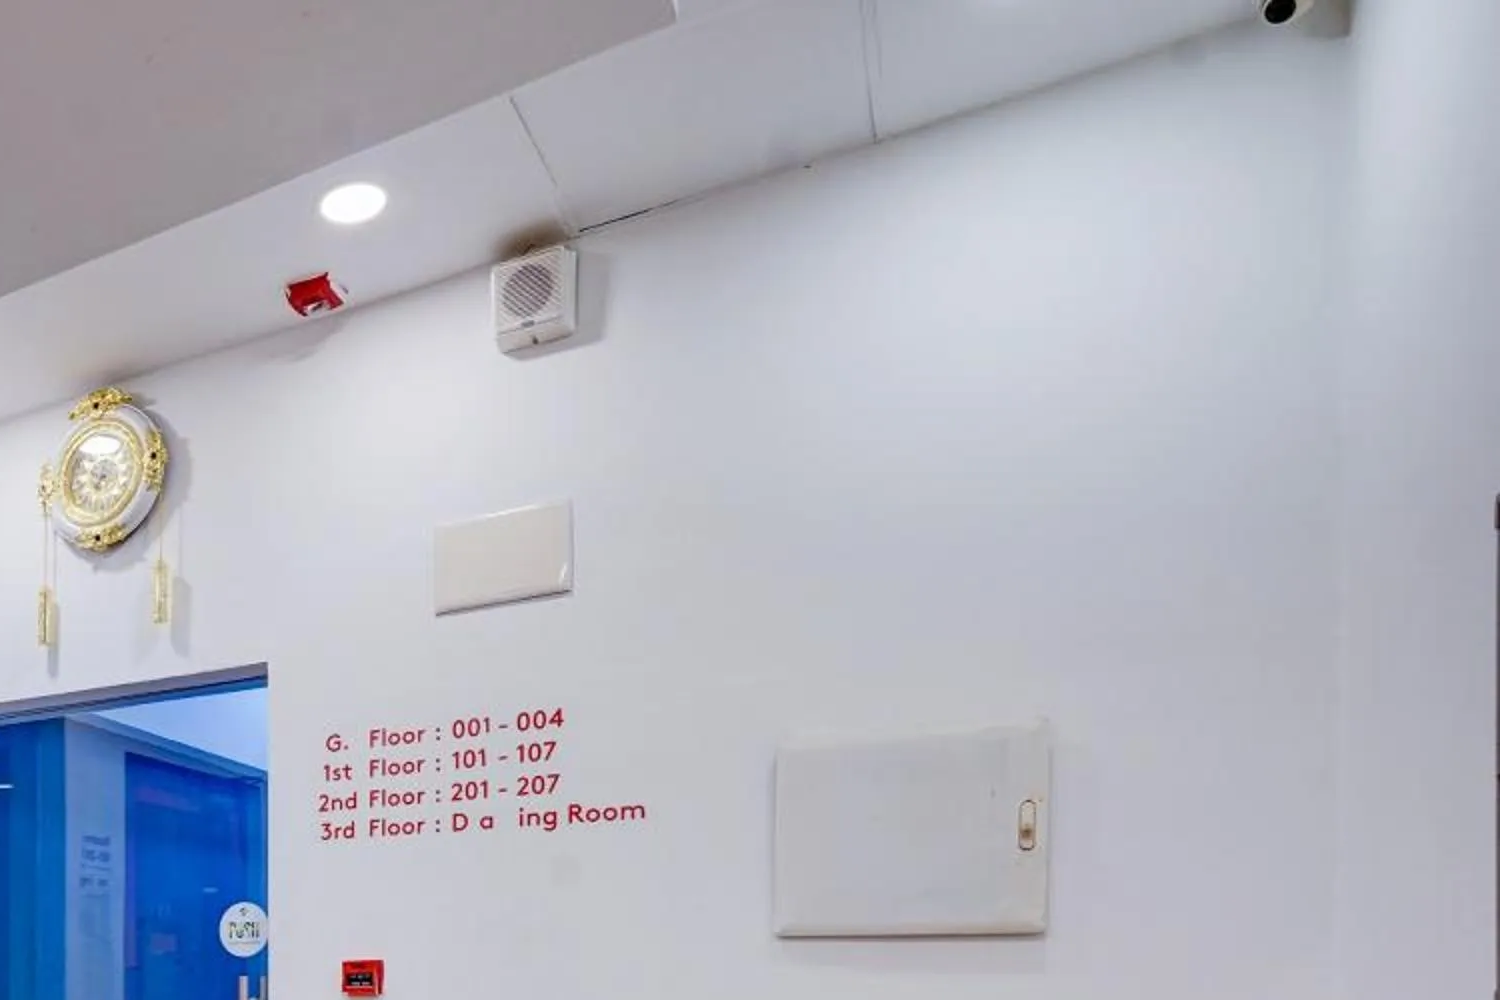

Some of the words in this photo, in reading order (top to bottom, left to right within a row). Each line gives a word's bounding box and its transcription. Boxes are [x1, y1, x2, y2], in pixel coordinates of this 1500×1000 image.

[325, 733, 349, 752] G.
[369, 728, 427, 749] Floor
[323, 763, 354, 782] 1st
[369, 757, 427, 779] Floor
[318, 790, 358, 812] 2nd
[369, 788, 427, 809] Floor
[320, 819, 356, 841] 3rd
[369, 817, 427, 839] Floor
[566, 803, 647, 825] Room
